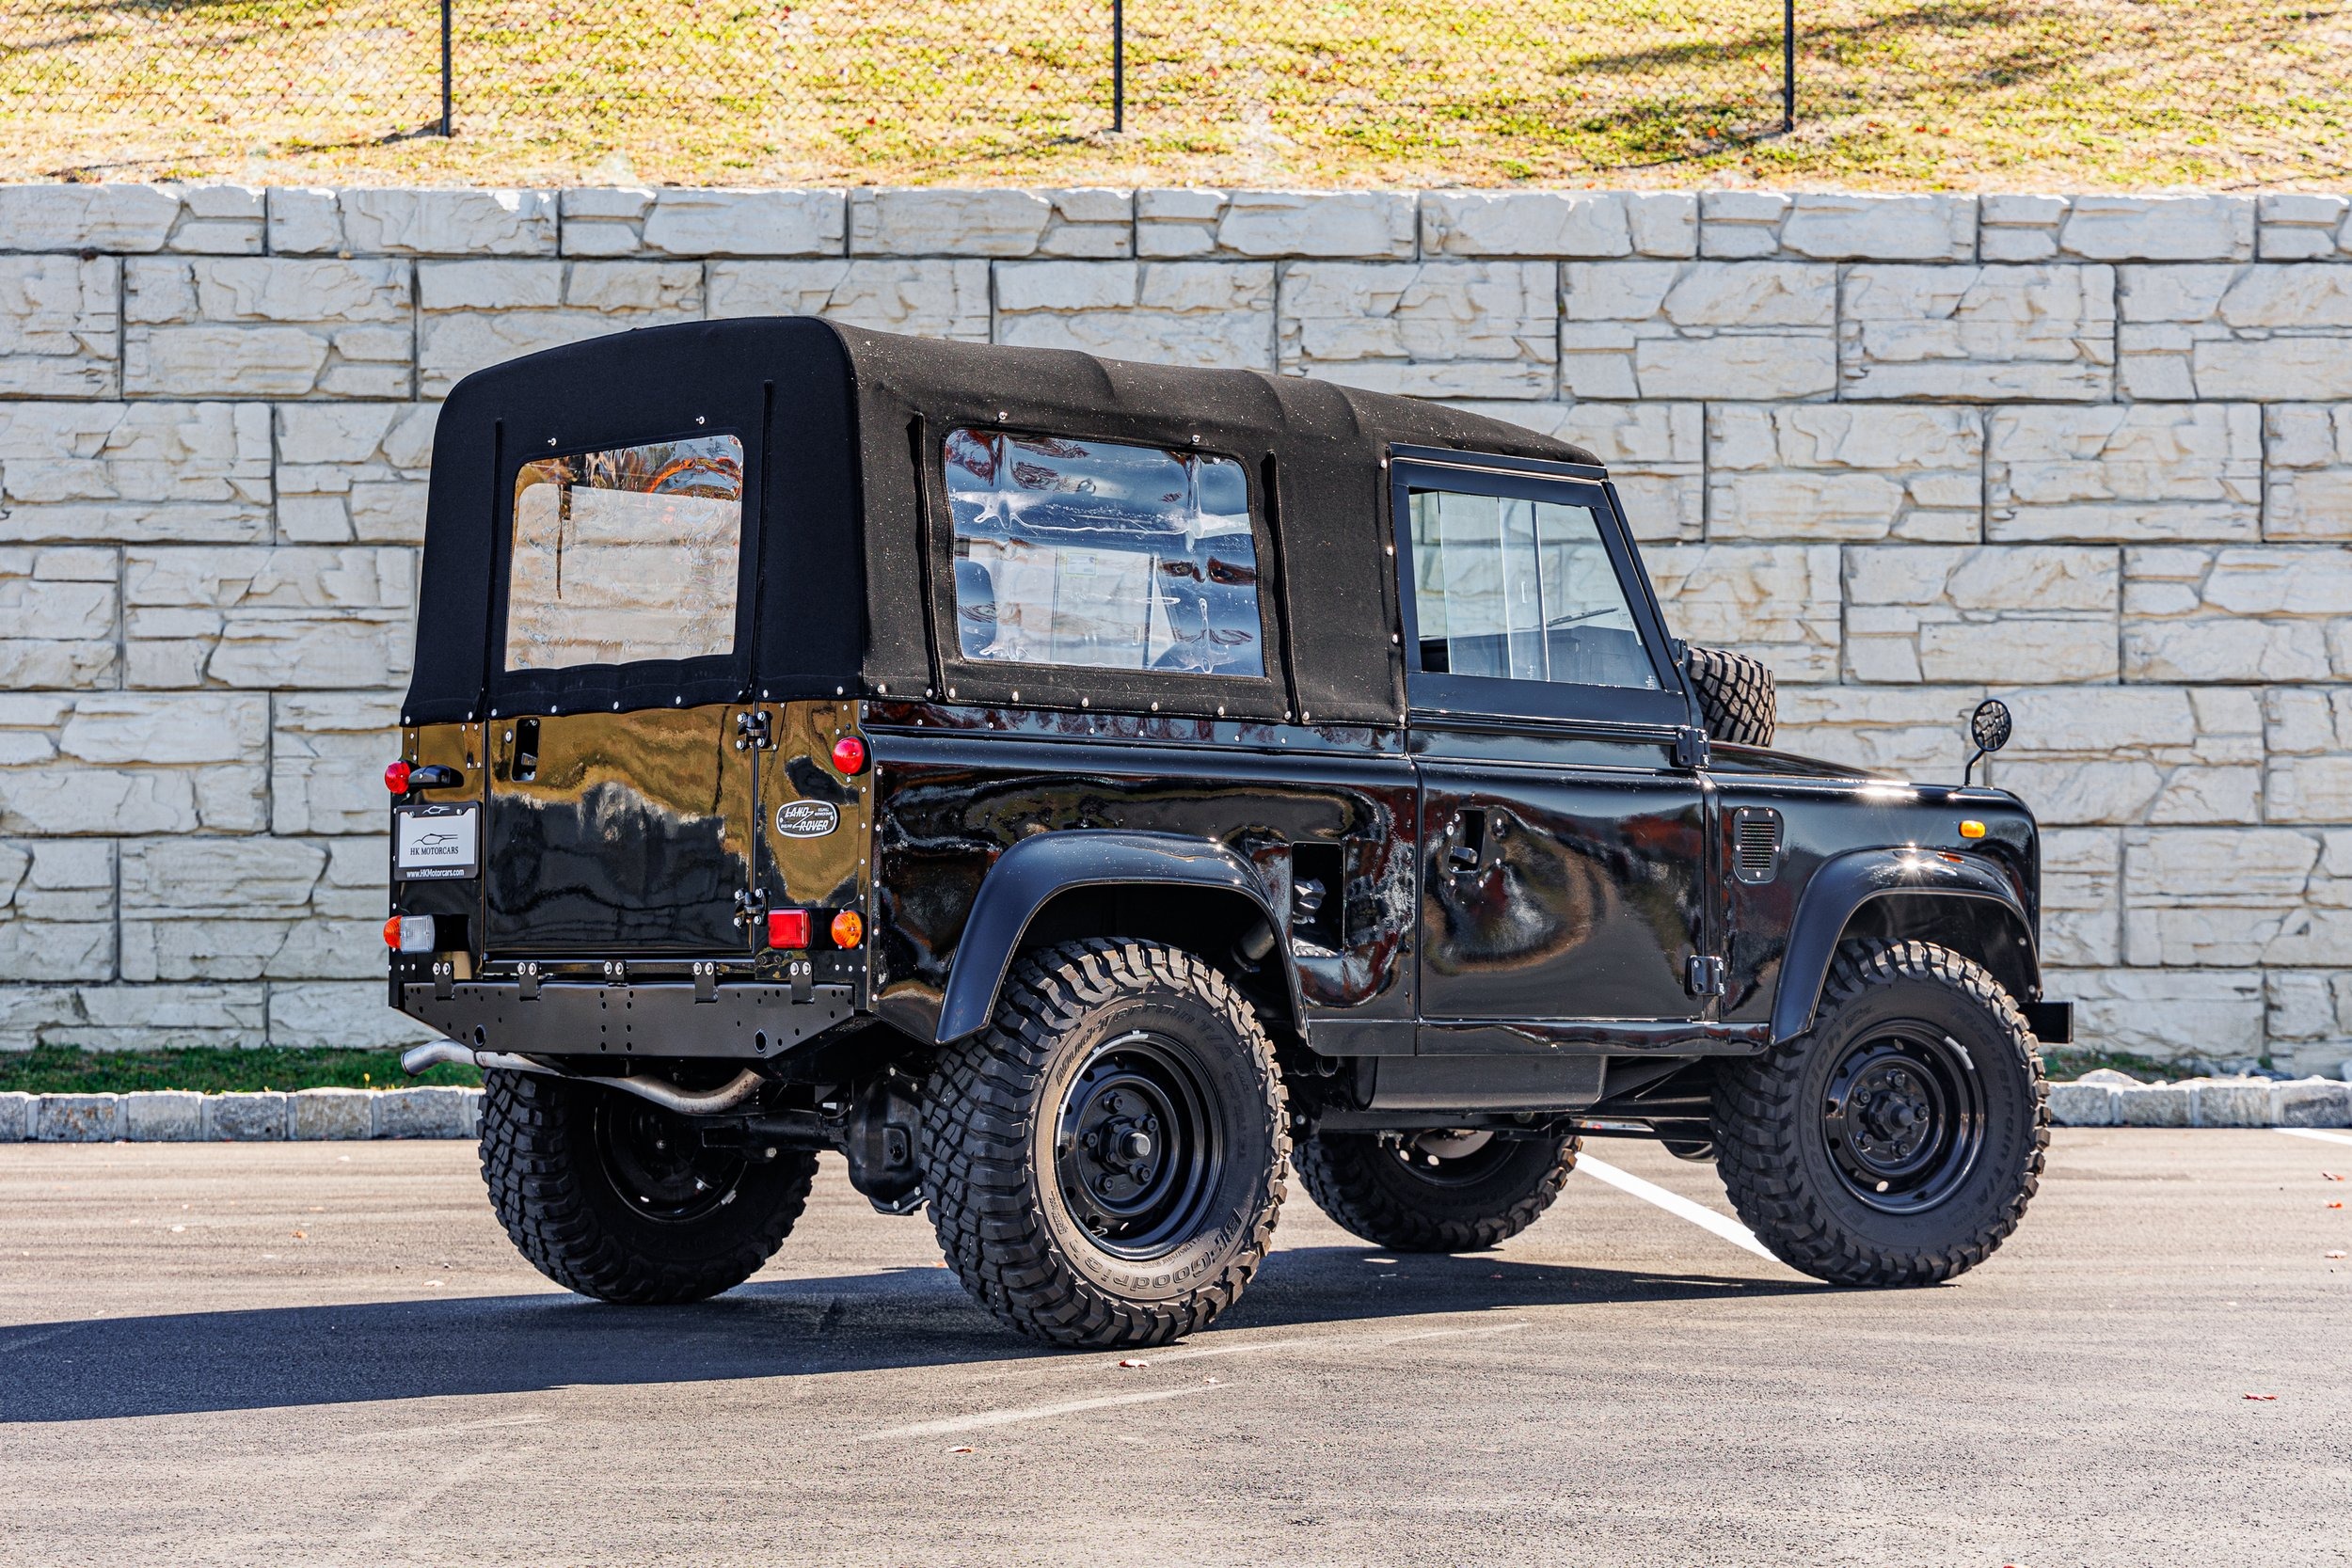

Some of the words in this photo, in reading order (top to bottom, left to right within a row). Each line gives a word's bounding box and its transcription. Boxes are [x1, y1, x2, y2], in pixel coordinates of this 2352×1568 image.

[785, 807, 810, 817] LAND
[799, 820, 829, 832] ROVER
[421, 847, 459, 855] MOTORCARS
[406, 868, 465, 879] www.HKMotorcars.com
[1064, 1207, 1243, 1292] BFGoodrich
